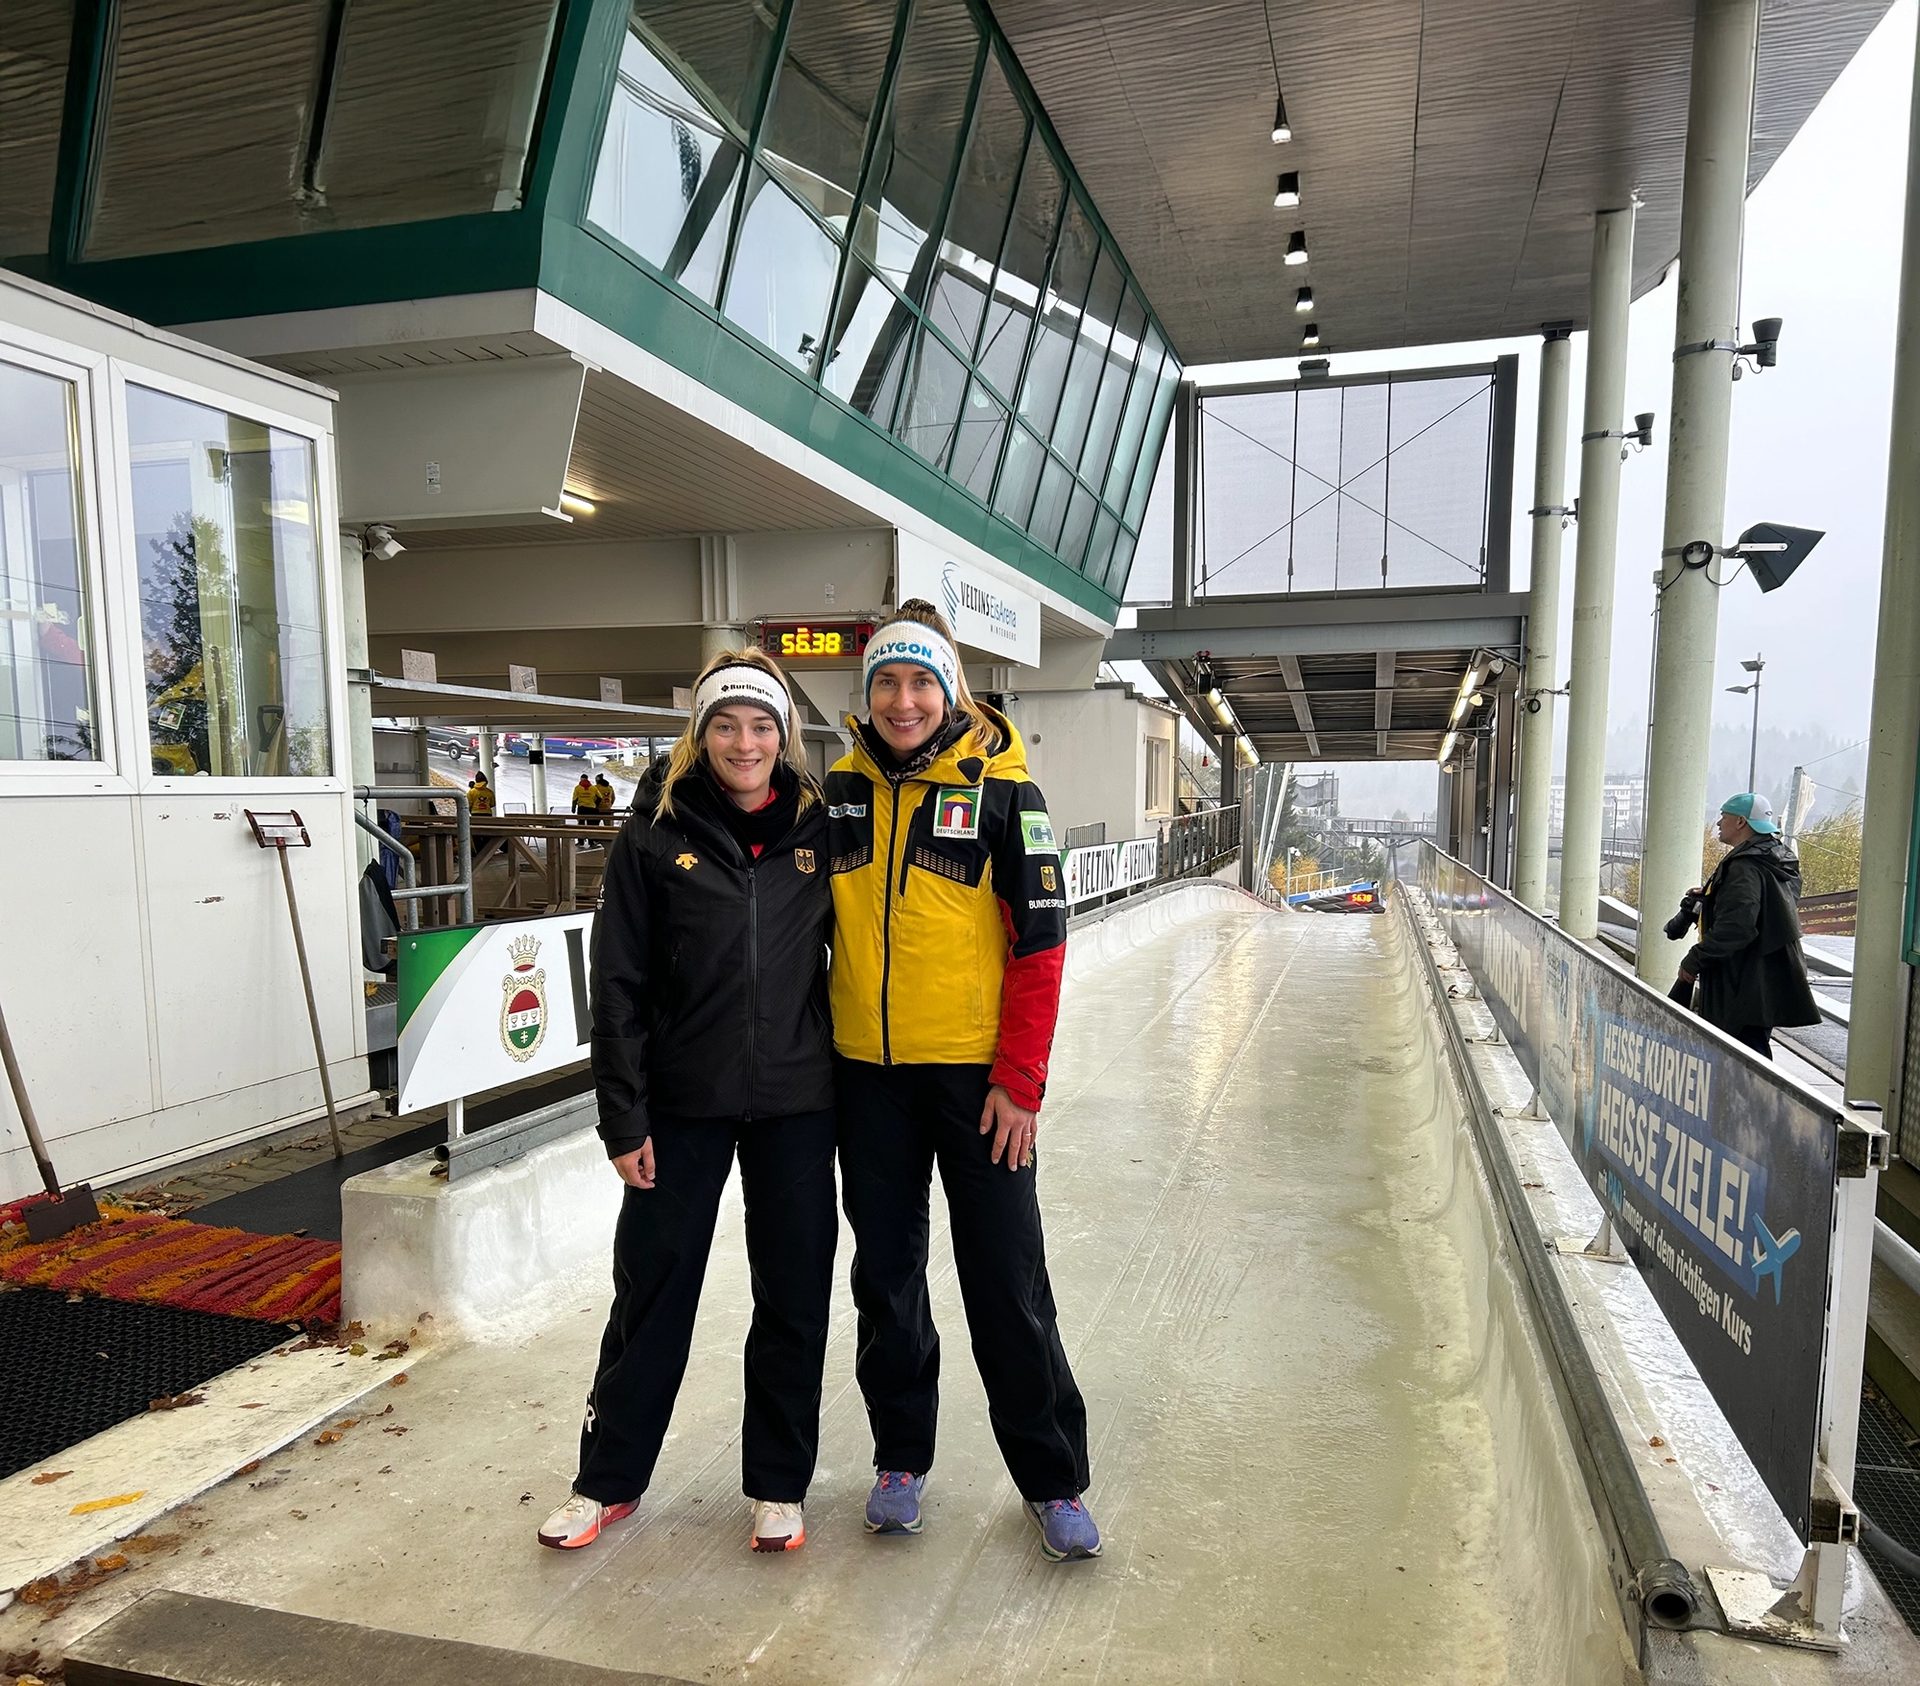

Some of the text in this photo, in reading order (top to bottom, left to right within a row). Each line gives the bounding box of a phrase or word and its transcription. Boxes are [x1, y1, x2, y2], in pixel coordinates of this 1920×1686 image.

[730, 684, 774, 699] Burlington
[936, 827, 976, 836] DEUTSCHLAND
[1079, 848, 1115, 897] VELTINS
[1129, 842, 1155, 882] VELTINS
[1602, 1021, 1644, 1084] HEISSE
[1644, 1038, 1712, 1121] KURVEN
[1598, 1080, 1750, 1267] HEISSE ZIELE!
[1622, 1190, 1644, 1234] immer
[1643, 1220, 1657, 1251] auf
[1656, 1228, 1675, 1273] dem
[1675, 1249, 1721, 1316] richtigen
[1721, 1292, 1753, 1356] Kurs
